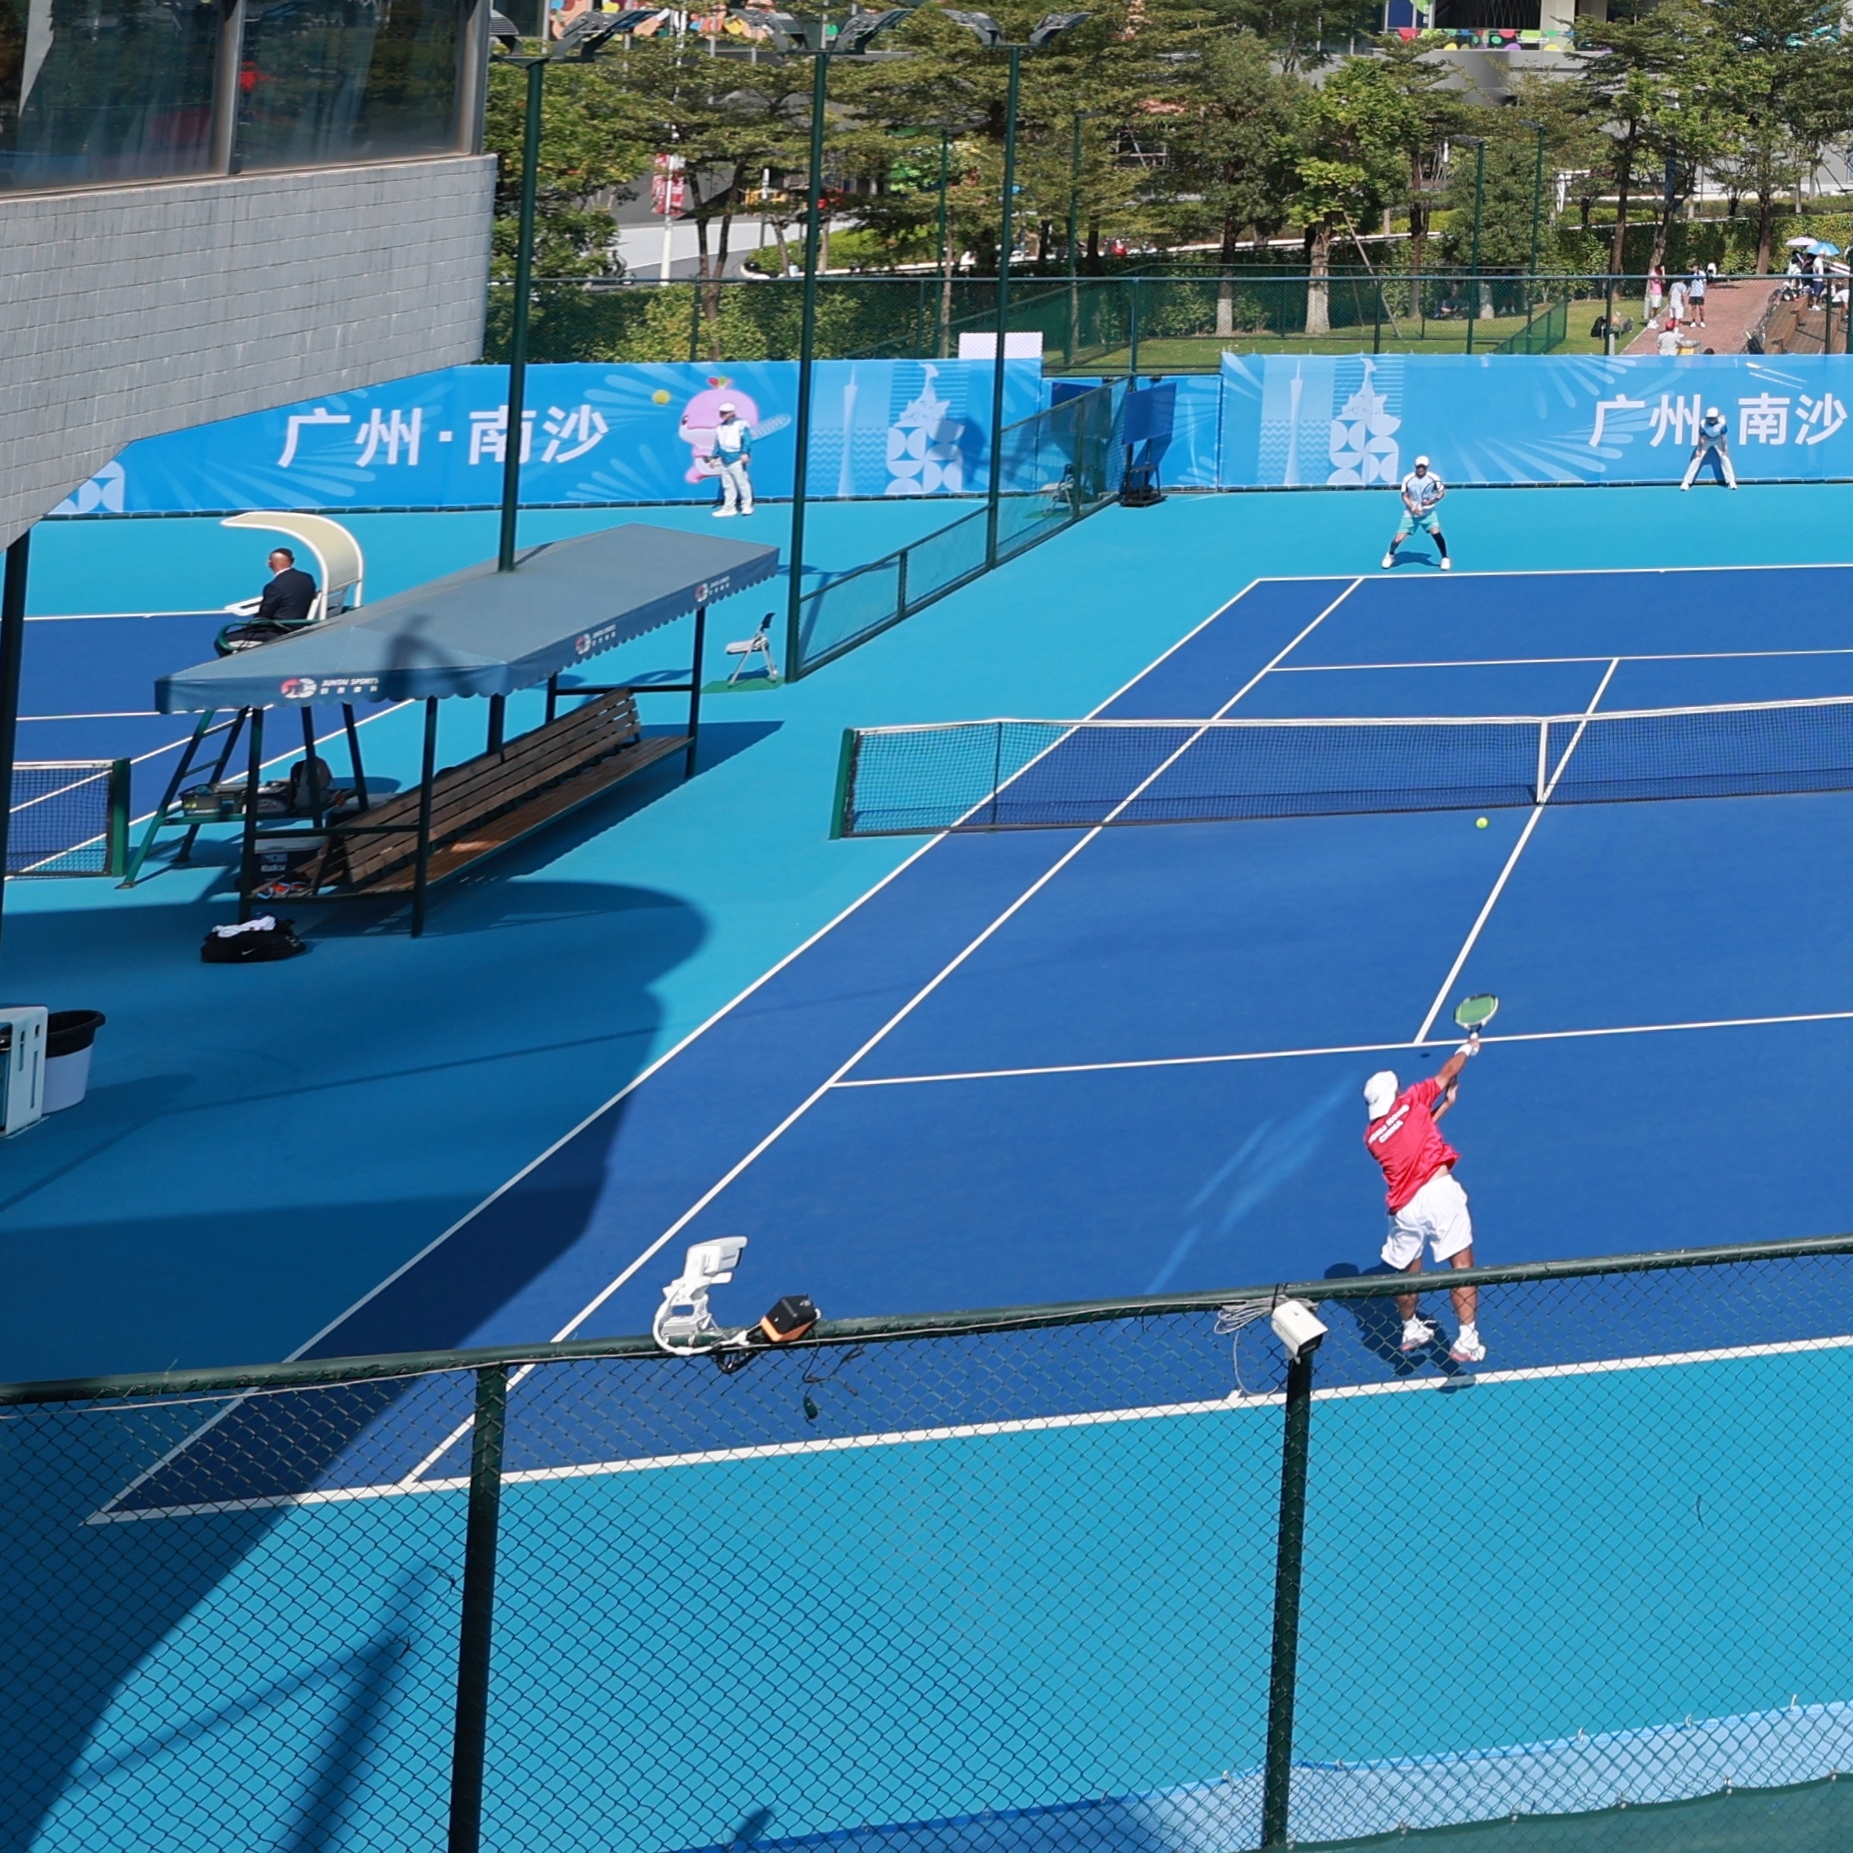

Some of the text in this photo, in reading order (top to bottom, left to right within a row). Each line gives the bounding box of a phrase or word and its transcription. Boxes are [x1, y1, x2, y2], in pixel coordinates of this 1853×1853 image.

[277, 404, 609, 468] 广州·南沙
[1588, 392, 1848, 448] 广州南沙
